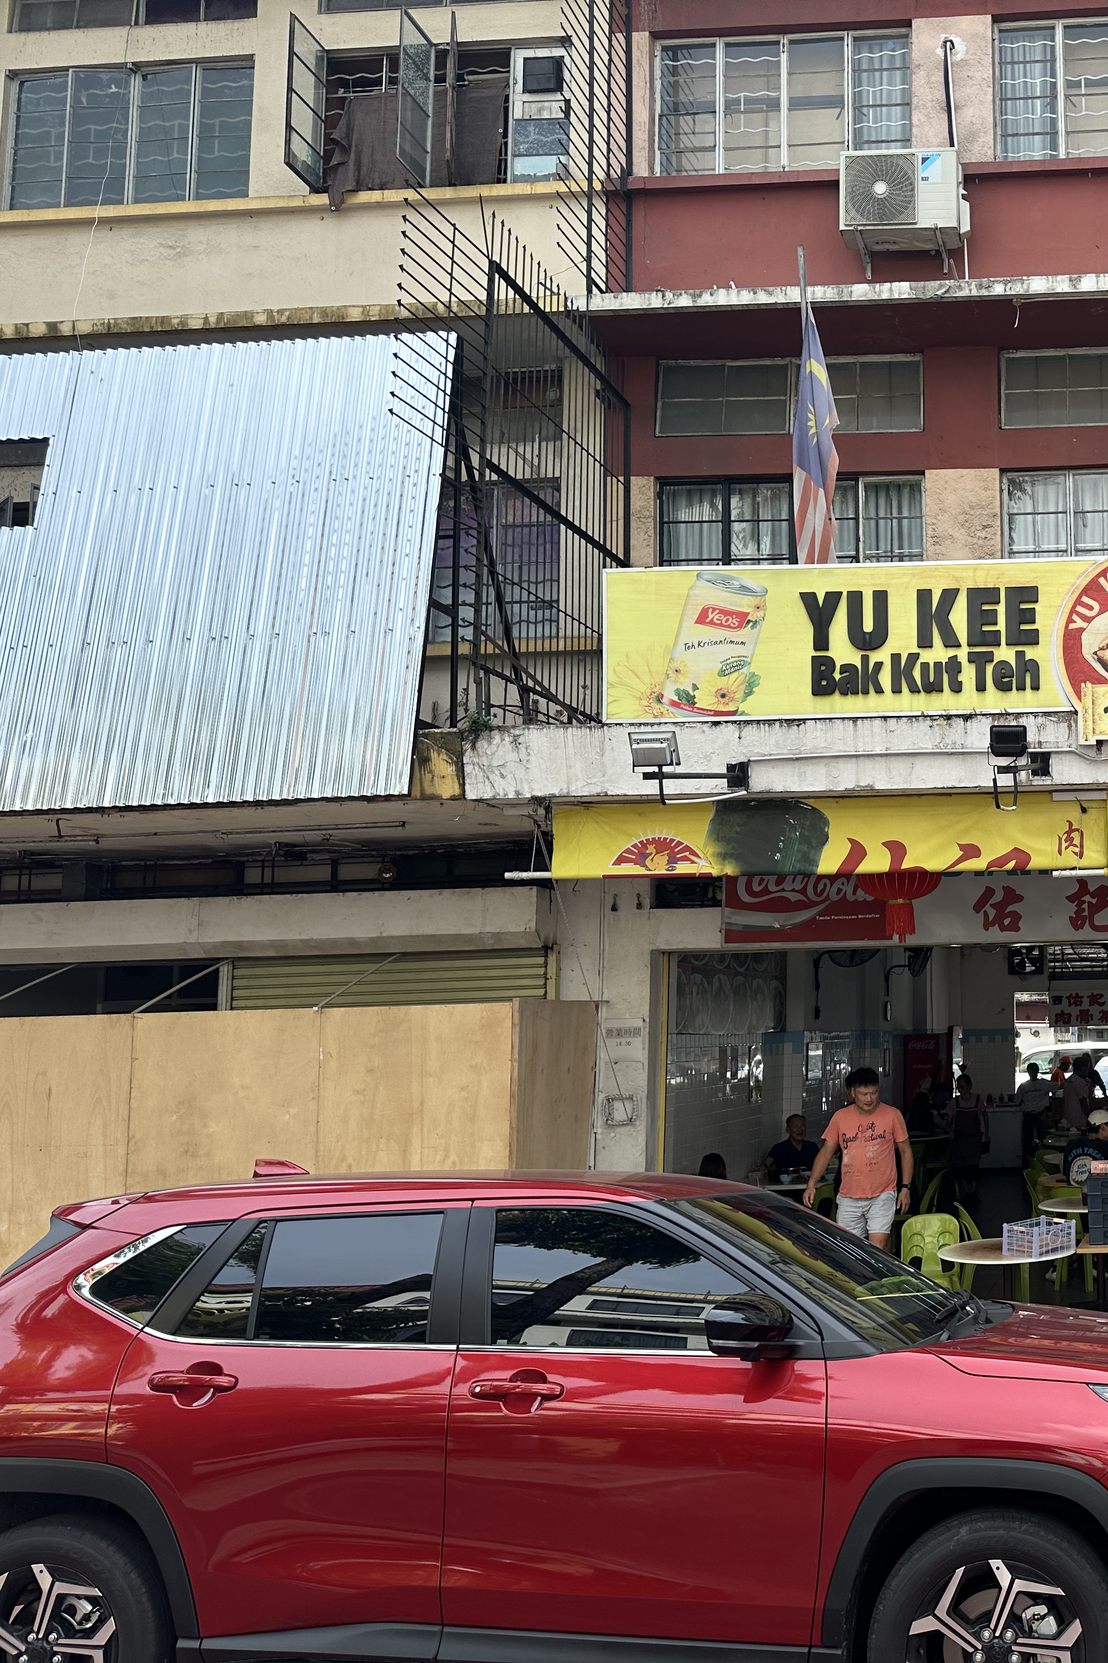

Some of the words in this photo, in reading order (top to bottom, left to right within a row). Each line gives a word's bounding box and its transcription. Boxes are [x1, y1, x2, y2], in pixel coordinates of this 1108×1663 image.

[705, 608, 740, 628] Yeo's
[798, 589, 889, 651] YU
[916, 585, 1040, 648] KEE
[1068, 595, 1101, 631] YU
[684, 642, 696, 652] Teh
[811, 653, 885, 696] Bak
[890, 652, 963, 693] Kut
[967, 650, 1040, 692] Teh
[1057, 820, 1084, 859] 肉
